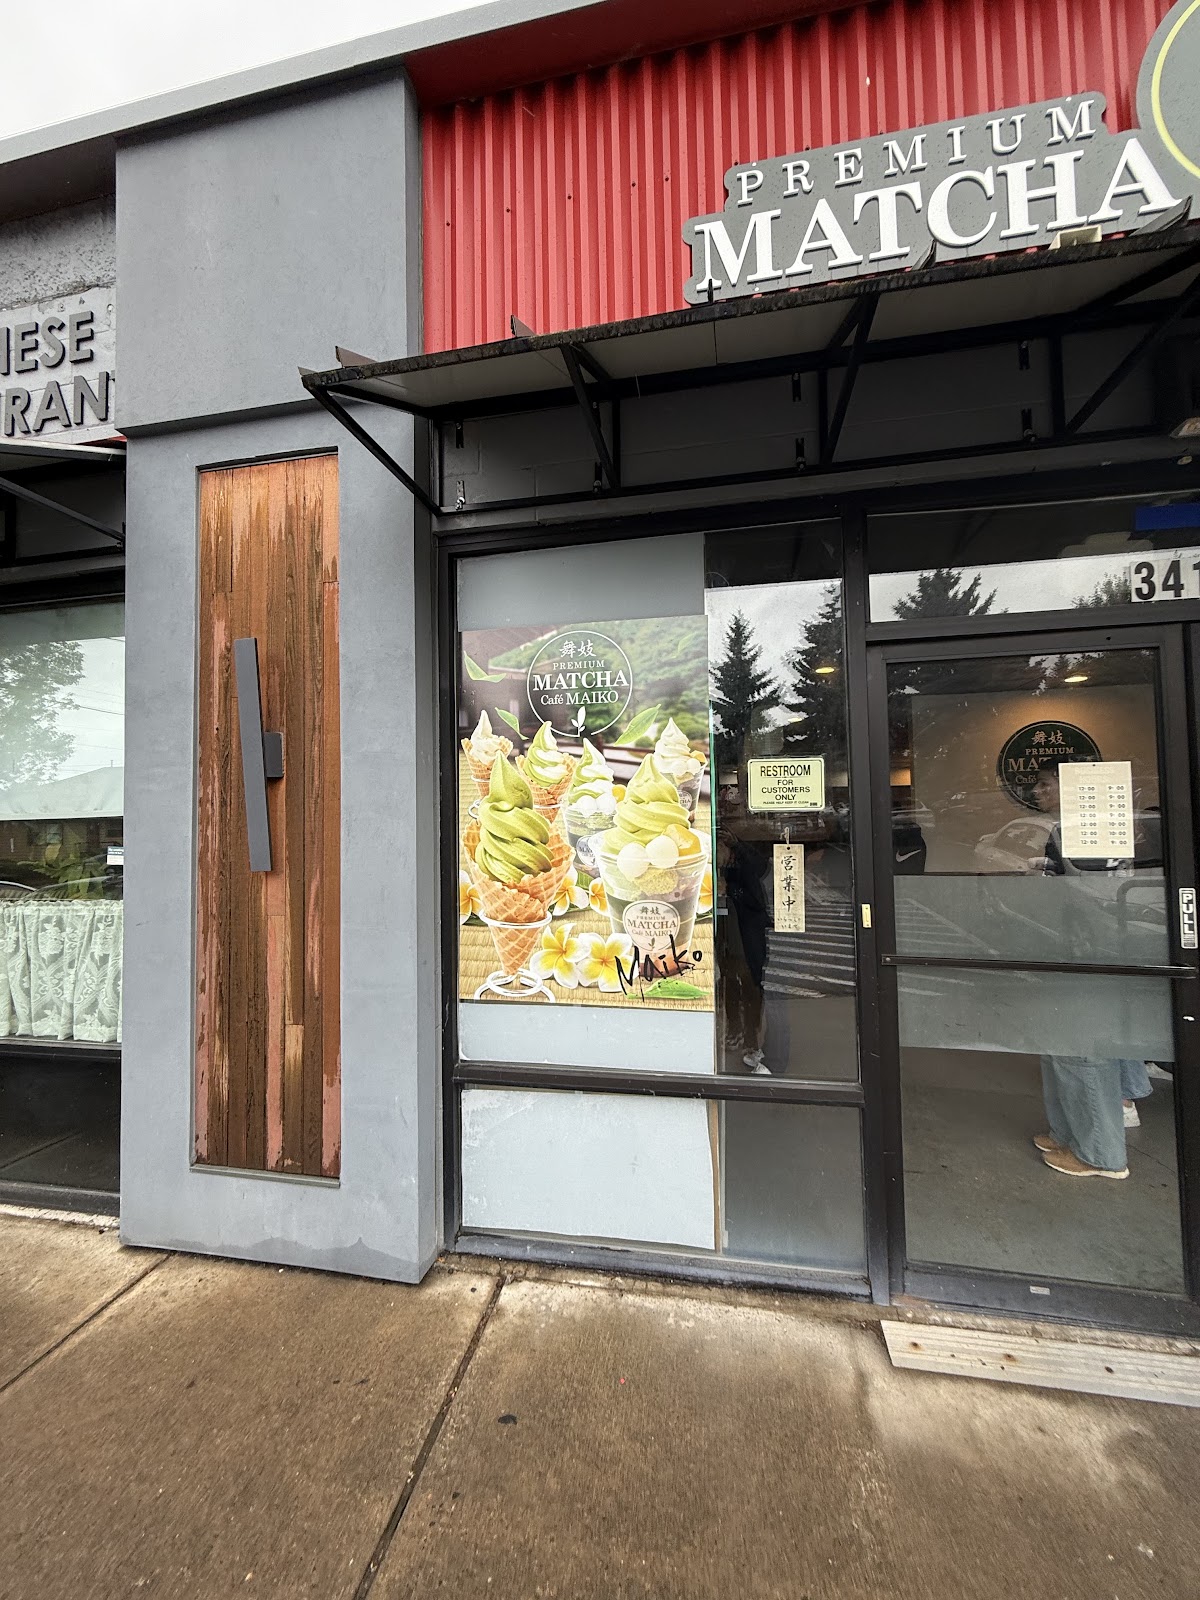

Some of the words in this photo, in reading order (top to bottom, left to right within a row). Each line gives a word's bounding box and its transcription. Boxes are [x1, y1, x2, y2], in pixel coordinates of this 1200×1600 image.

[735, 99, 1097, 206] PREMIUM
[694, 136, 1184, 292] MATCHA
[560, 639, 597, 658] 舞妓
[553, 660, 605, 671] PREMIUM
[532, 669, 630, 691] MATCHA
[540, 694, 564, 706] Café
[565, 690, 619, 705] MAIKO
[1031, 729, 1067, 746] 舞妓
[1025, 747, 1075, 755] PREMIUM
[760, 764, 811, 777] RESTROOM
[1015, 774, 1037, 784] Café
[761, 786, 811, 794] CUSTOMERS
[780, 855, 798, 912] 営業中
[1182, 893, 1195, 934] PULL
[627, 918, 677, 931] MATCHA
